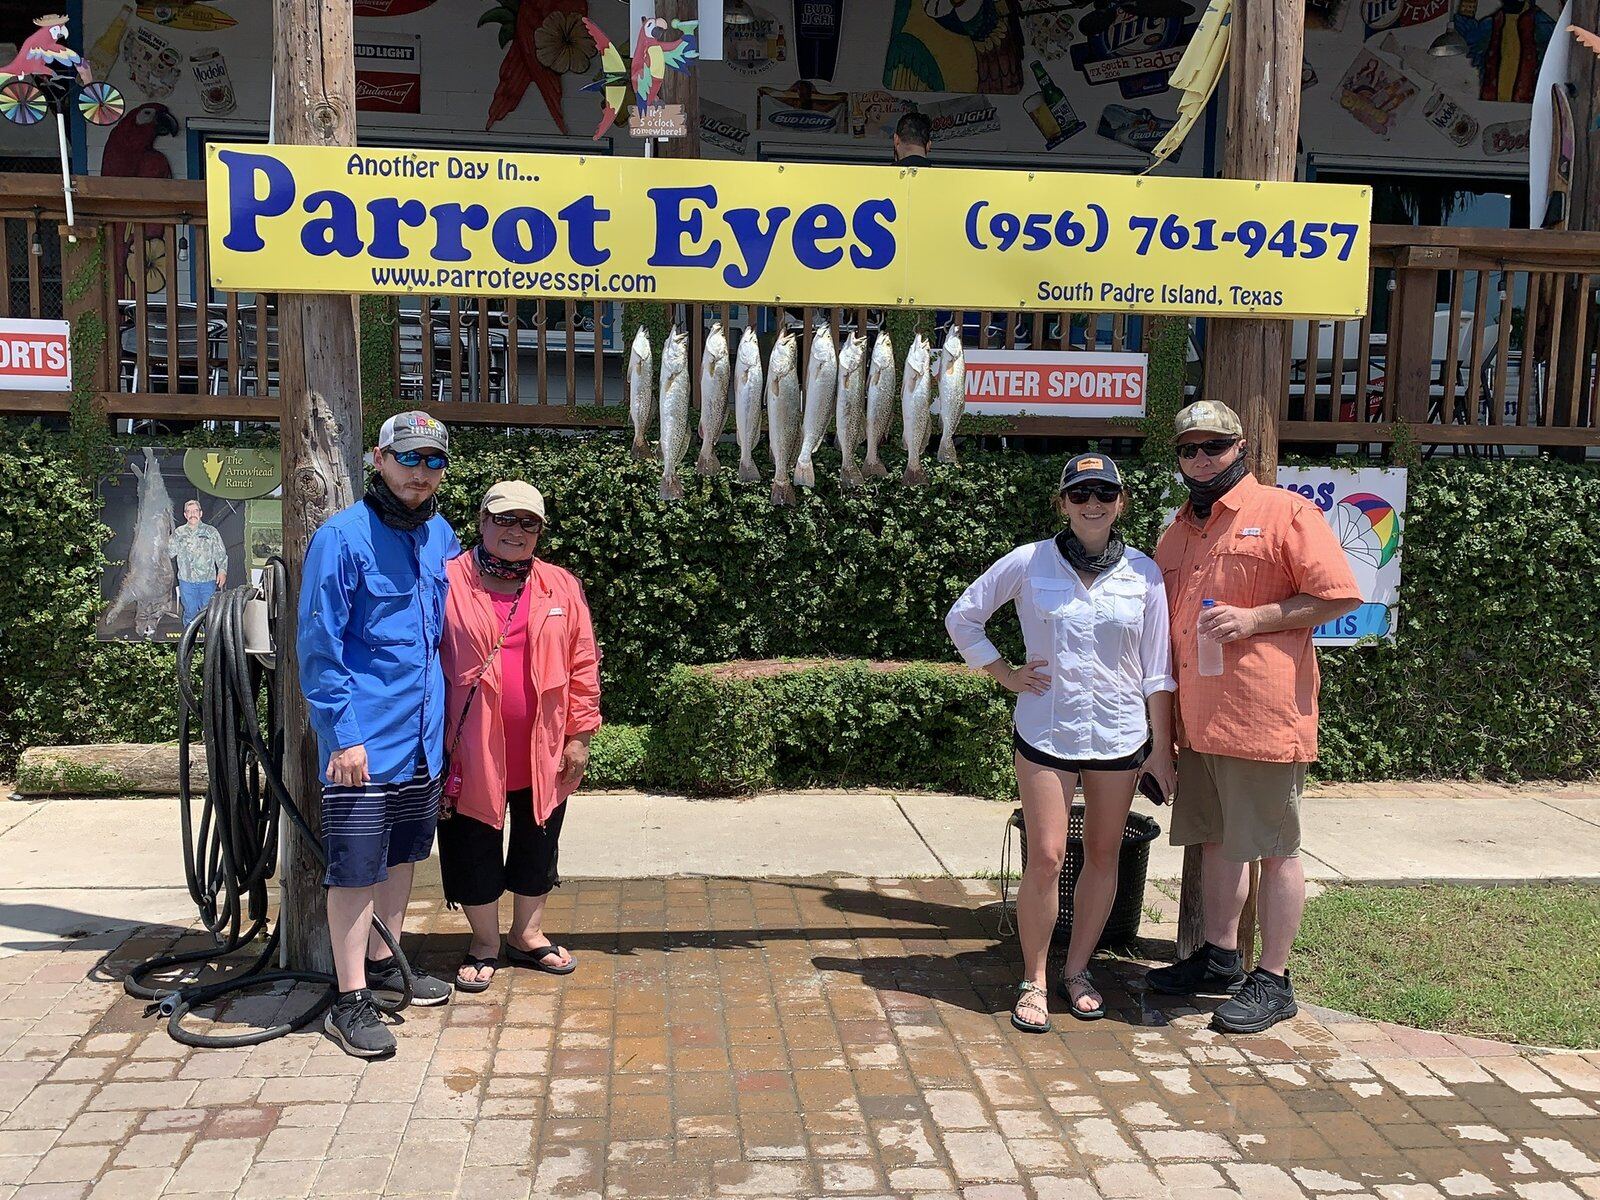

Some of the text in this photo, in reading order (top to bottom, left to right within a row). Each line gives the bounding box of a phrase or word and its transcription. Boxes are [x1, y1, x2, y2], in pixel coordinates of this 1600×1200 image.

[804, 3, 833, 14] BUD
[376, 47, 412, 58] LIGHT
[1101, 58, 1130, 72] South
[356, 84, 408, 97] Budweiser
[647, 117, 675, 128] o'clock
[775, 115, 831, 126] BUD LIGHT
[955, 107, 997, 125] LIGHT
[631, 126, 682, 136] somewhere!
[704, 118, 750, 142] LIGHT
[347, 152, 540, 182] Another Day In...
[218, 150, 898, 289] Parrot Eyes
[964, 200, 1359, 262] (956) 761-9457
[371, 267, 657, 294] www.parroteyesspi.com
[1037, 280, 1283, 306] South Padre Island, Texas
[965, 369, 1141, 399] WATER SPORTS
[225, 454, 243, 465] The
[225, 466, 274, 477] Arrowhead
[225, 477, 253, 488] Ranch
